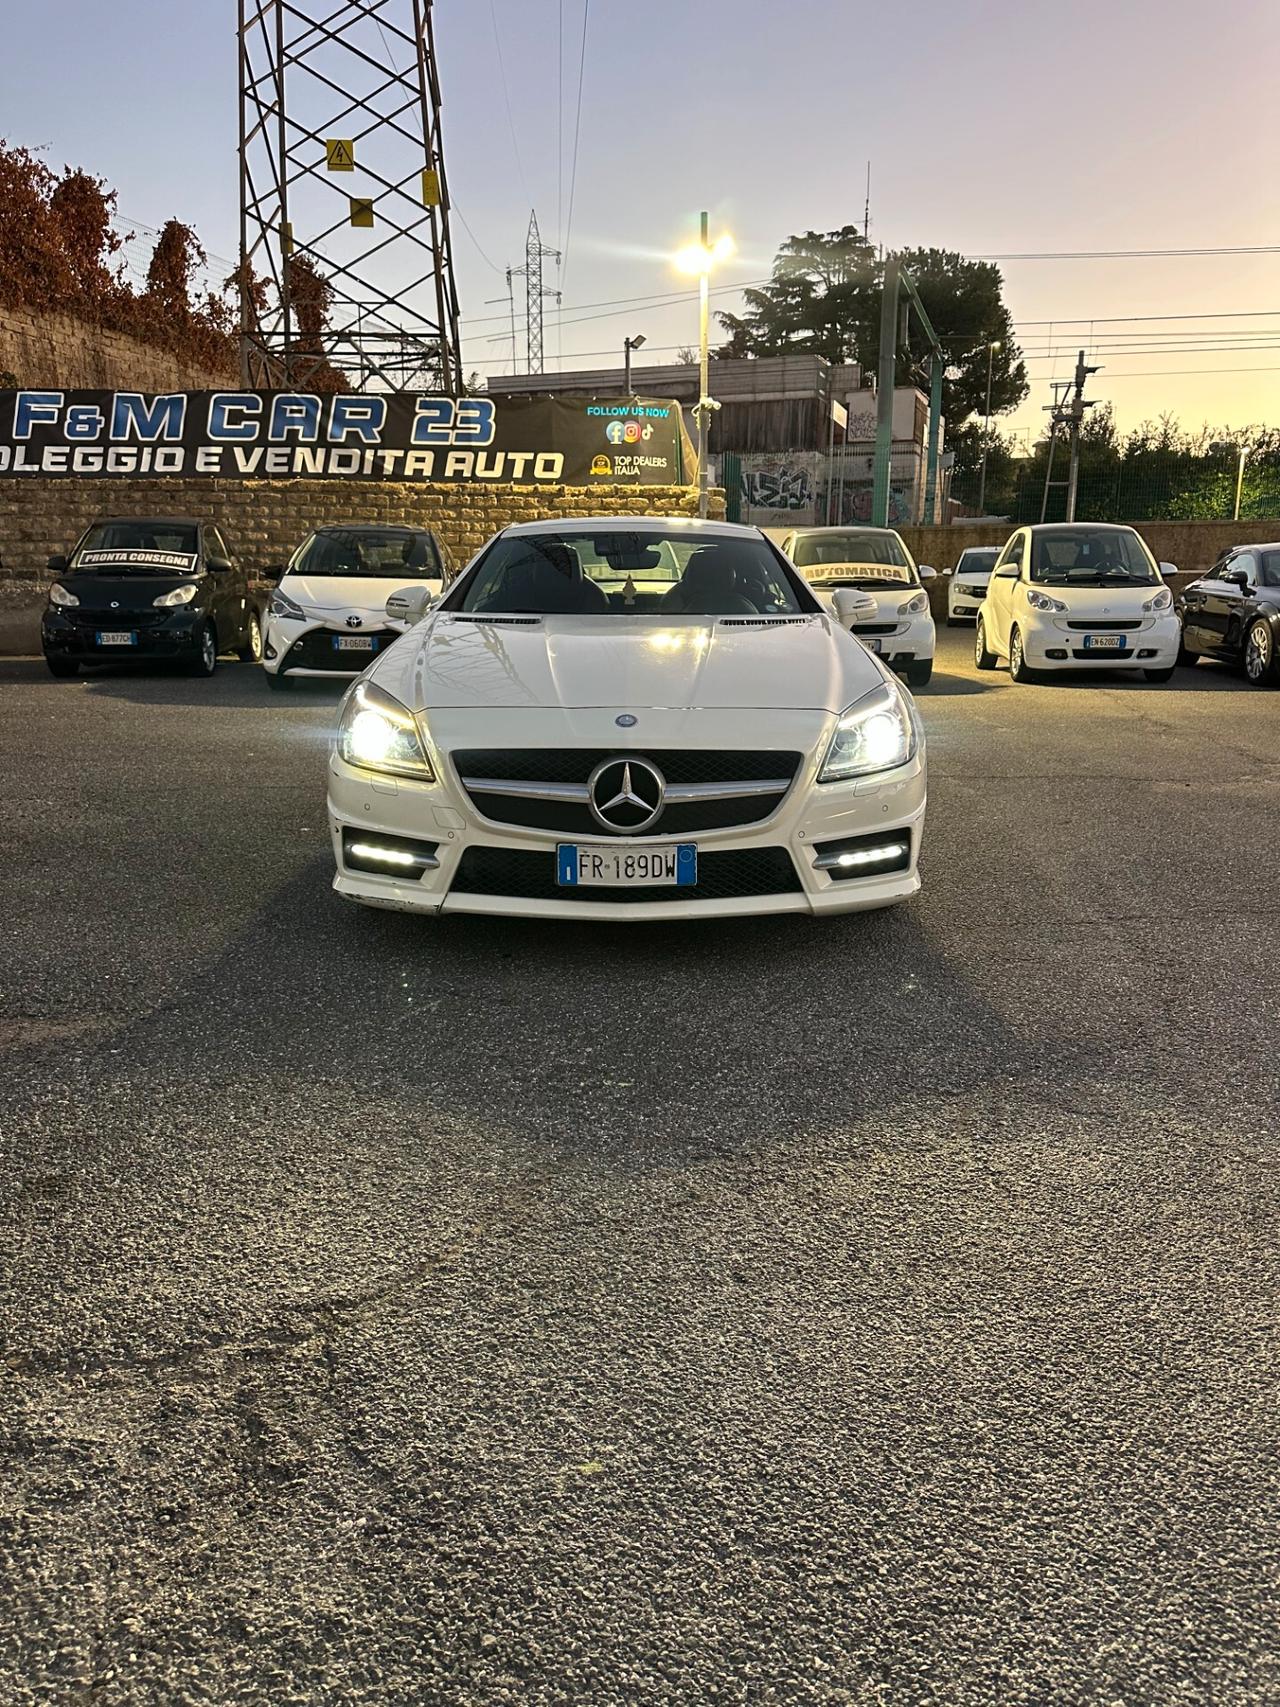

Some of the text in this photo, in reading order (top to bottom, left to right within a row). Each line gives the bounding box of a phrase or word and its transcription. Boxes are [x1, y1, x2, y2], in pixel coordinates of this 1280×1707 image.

[12, 391, 497, 446] F&M CAR 23
[587, 407, 669, 418] FOLLOW US NOW
[195, 446, 224, 473] E
[233, 446, 435, 476] VENDITA
[444, 451, 564, 479] AUTO
[614, 456, 632, 466] TOP
[633, 456, 667, 468] DEALERS
[614, 466, 640, 475] ITALIA
[84, 553, 189, 566] PRONTA CONSEGNA
[805, 567, 903, 578] AUTOMATICA
